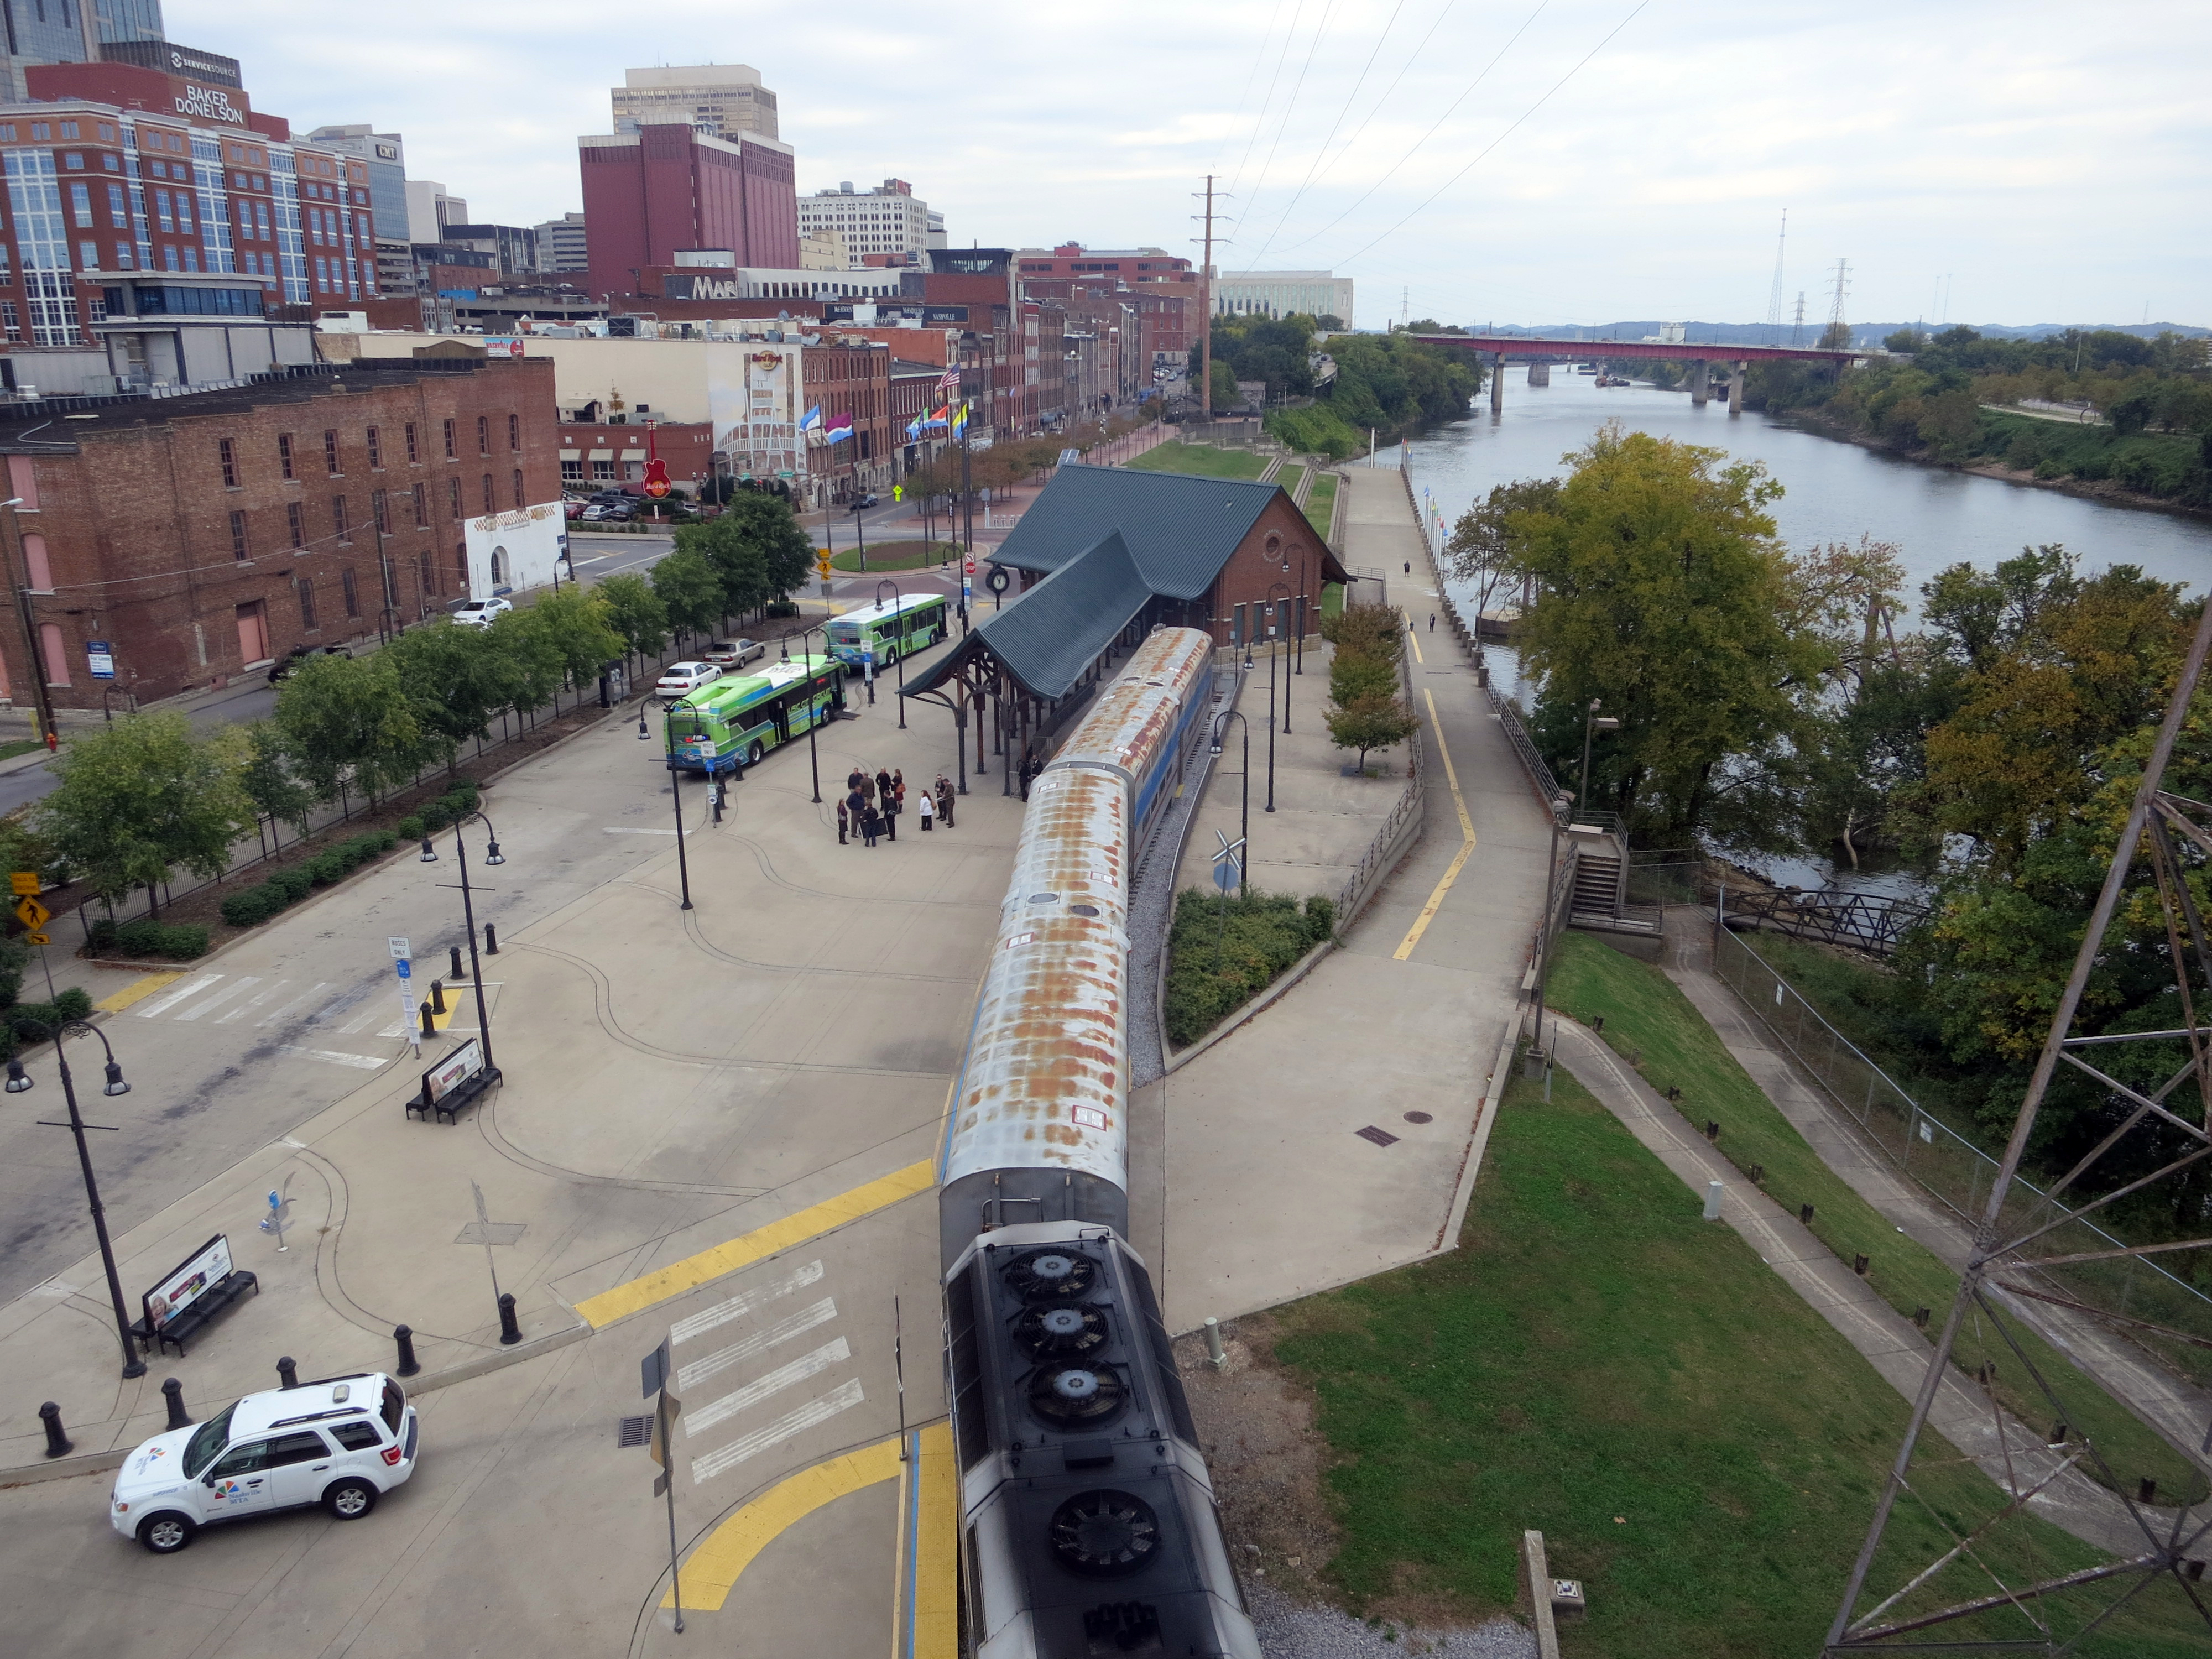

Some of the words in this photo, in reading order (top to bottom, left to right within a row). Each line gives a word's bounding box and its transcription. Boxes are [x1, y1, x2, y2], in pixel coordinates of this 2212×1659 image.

[183, 58, 237, 77] SERVICESOURCE
[186, 85, 228, 108] BAKER
[174, 97, 243, 124] DONELSON
[379, 145, 395, 159] CMT
[752, 353, 768, 362] Hard
[768, 353, 783, 363] Rock
[228, 1489, 262, 1499] Nashville
